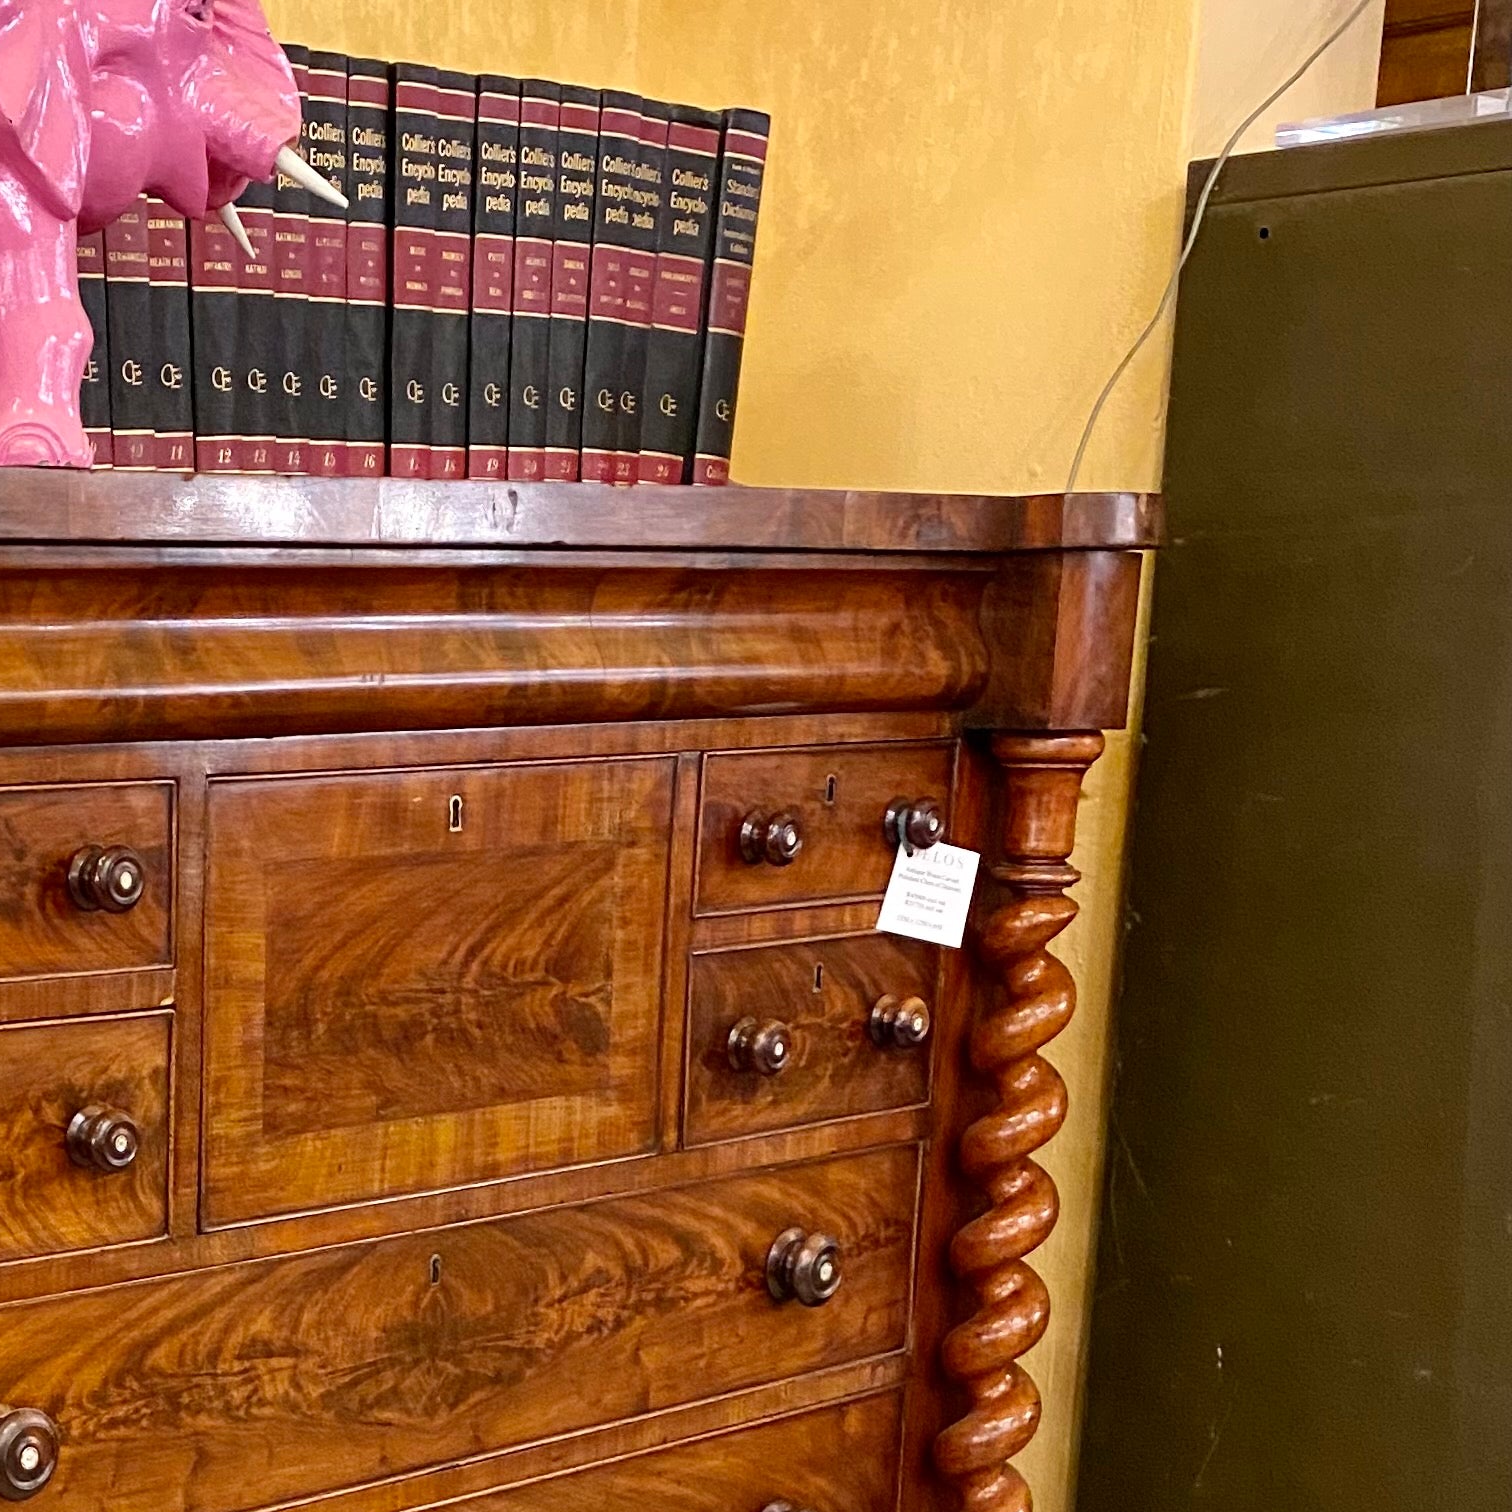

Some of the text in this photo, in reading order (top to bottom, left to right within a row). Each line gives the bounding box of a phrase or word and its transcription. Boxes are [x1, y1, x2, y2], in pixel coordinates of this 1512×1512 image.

[402, 133, 436, 154] Collier's
[438, 138, 471, 160] Collier's
[481, 142, 516, 163] Collier's
[521, 147, 555, 168] Collier's
[561, 151, 595, 172] Collier's
[672, 169, 709, 191] Collier's
[358, 181, 384, 201] pedia
[407, 186, 431, 206] pedia
[442, 191, 468, 211] pedia
[486, 194, 512, 213] pedia
[525, 198, 550, 217] pedia
[564, 202, 589, 221] pedia
[606, 206, 629, 224] pedia
[673, 218, 699, 236] pedia
[170, 445, 183, 461] 11
[218, 447, 232, 464] 12
[254, 449, 267, 463] 13
[288, 450, 301, 466] 14
[364, 453, 376, 469] 16
[486, 458, 499, 472] 19
